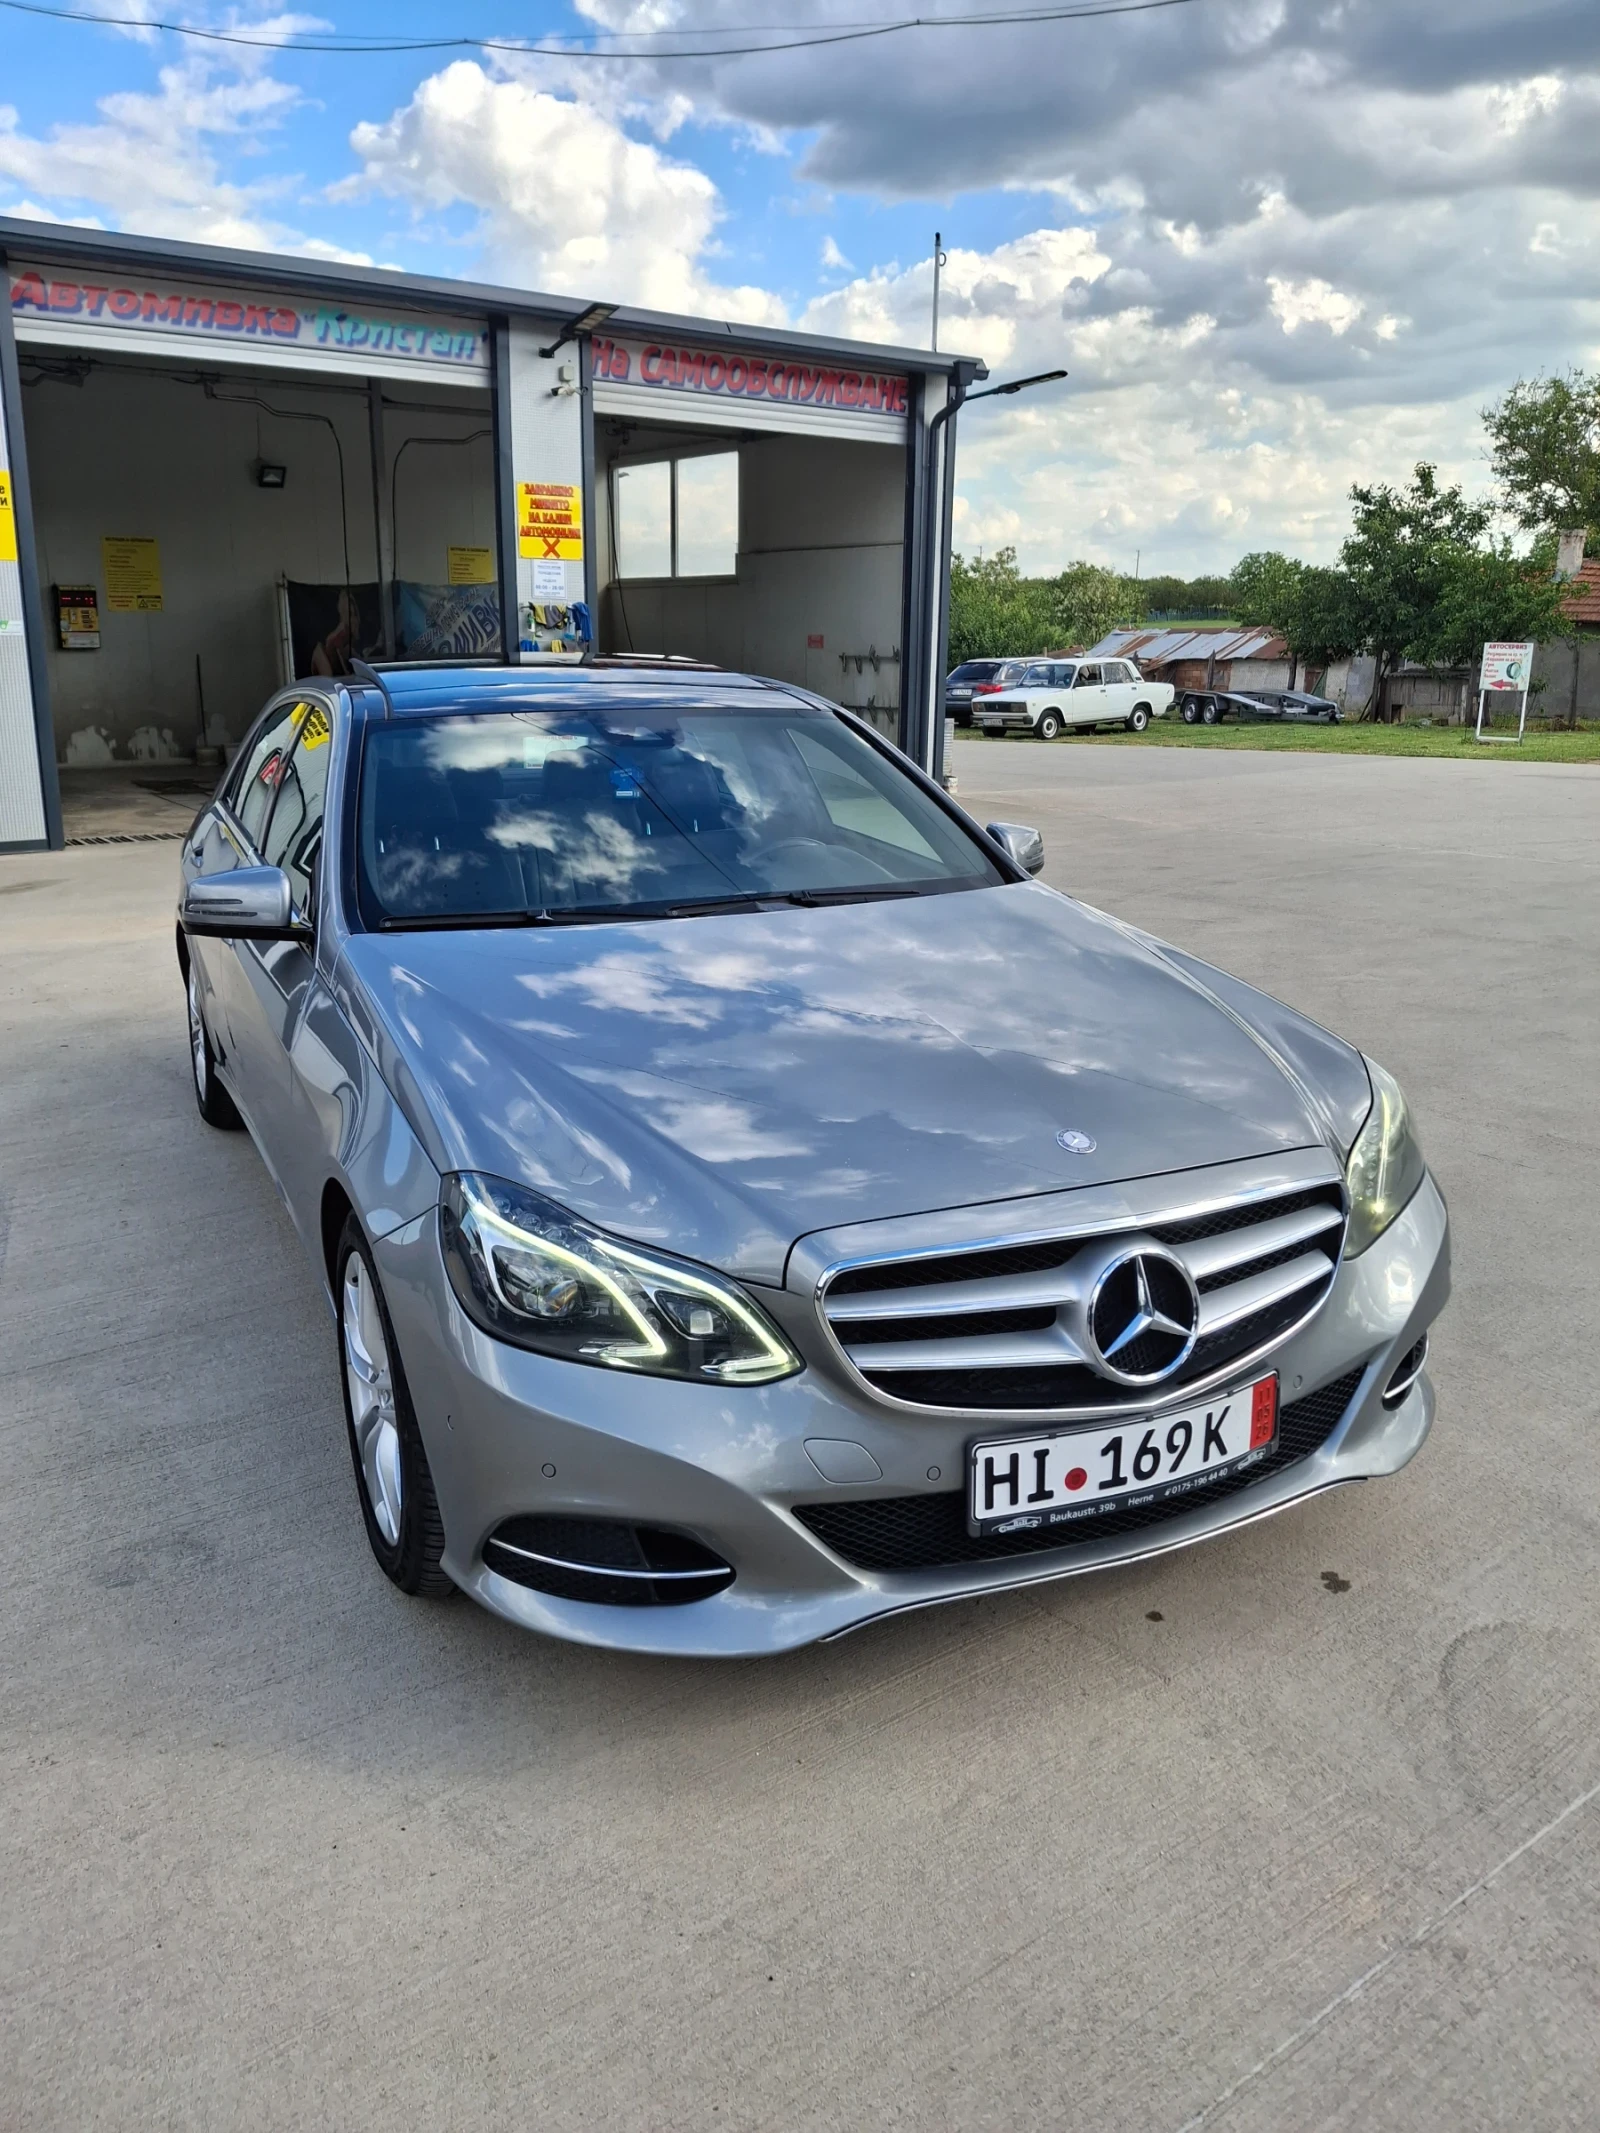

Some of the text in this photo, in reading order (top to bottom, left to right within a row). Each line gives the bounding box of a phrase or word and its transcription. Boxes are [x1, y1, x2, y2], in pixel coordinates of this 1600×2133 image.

[984, 1448, 1054, 1511] HI
[1050, 1507, 1097, 1523] Baukaustr.
[1098, 1501, 1116, 1514] 39b
[1128, 1494, 1154, 1507] Herne
